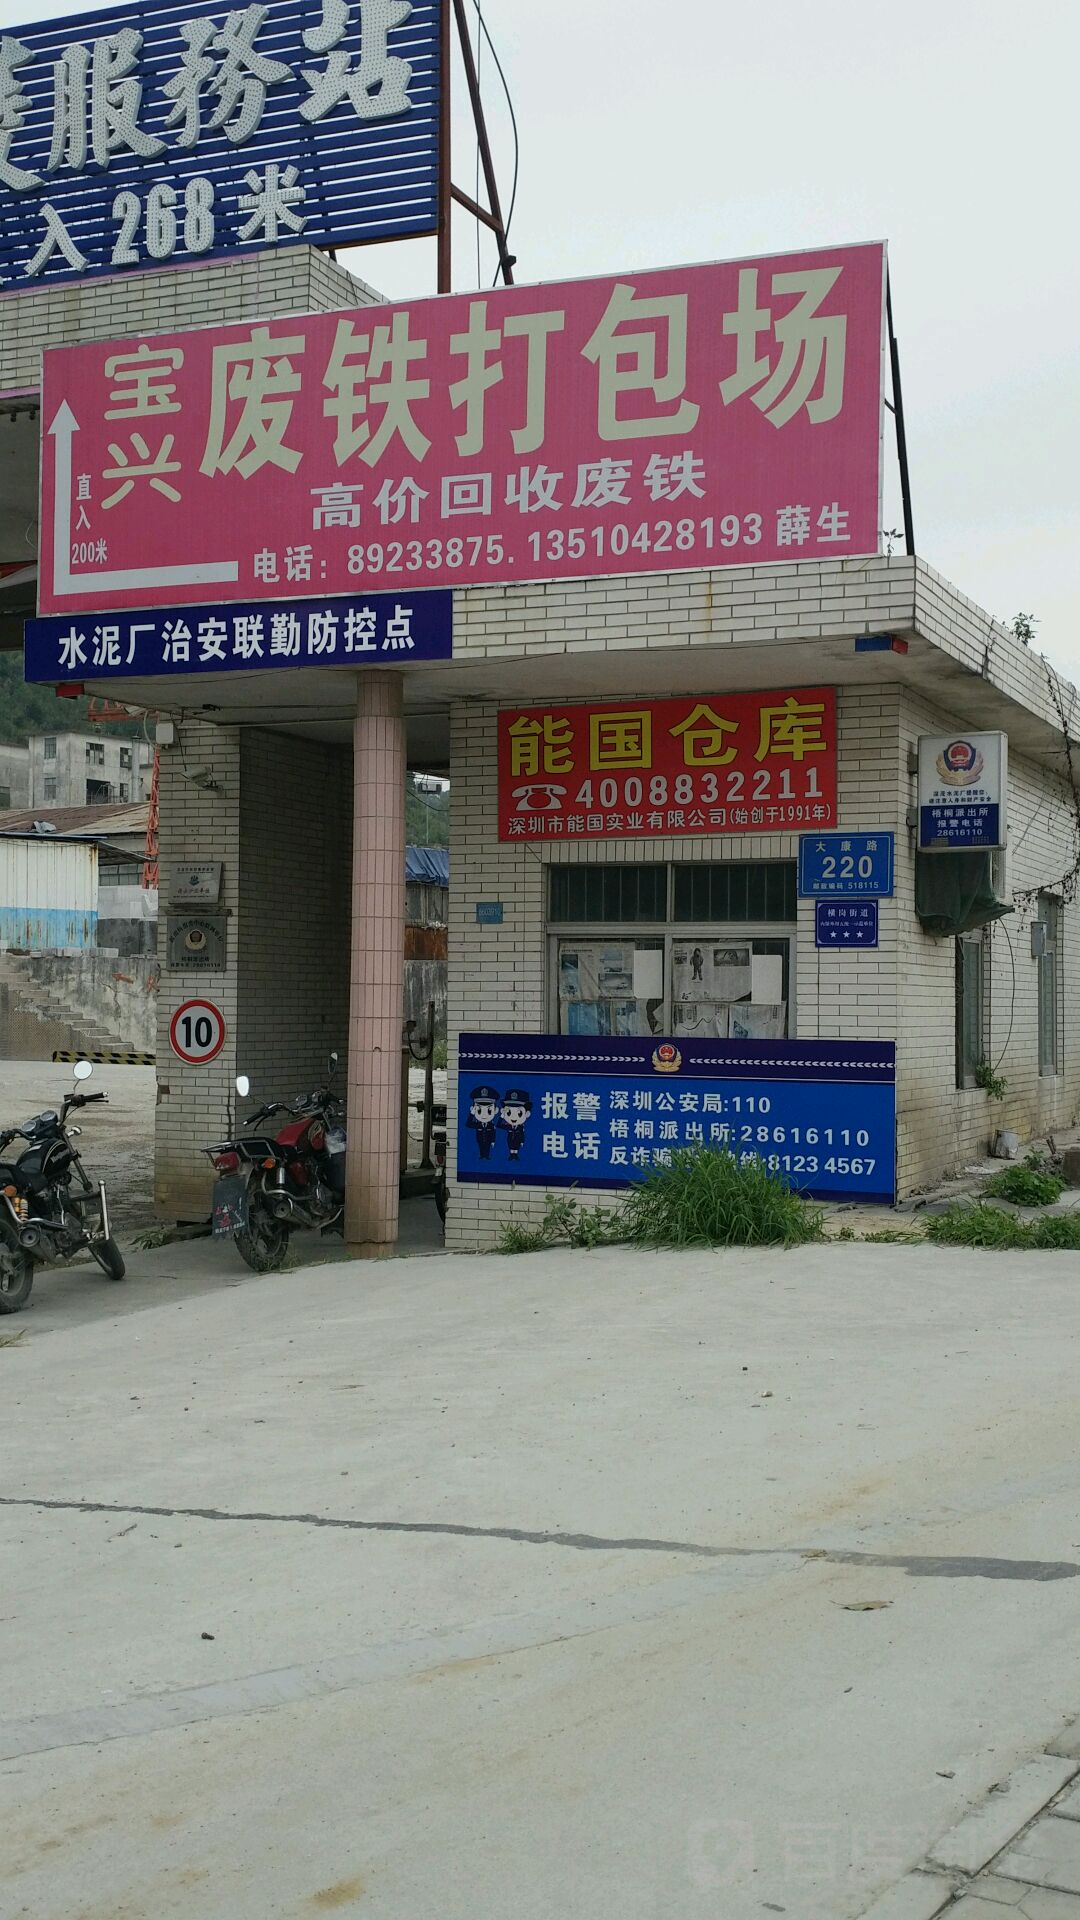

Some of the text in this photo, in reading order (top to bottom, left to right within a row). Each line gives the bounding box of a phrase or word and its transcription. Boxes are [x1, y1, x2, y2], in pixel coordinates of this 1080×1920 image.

[198, 266, 848, 480] 废铁打包场
[101, 344, 184, 510] 宝兴
[310, 450, 707, 530] 高价回收废铁
[71, 538, 108, 564] 200米
[58, 604, 416, 670] 水泥厂治安联勤防控点
[507, 696, 828, 778] 能国仓库
[575, 766, 824, 810] 4008832211
[936, 818, 984, 828] 报警电话
[937, 828, 983, 837] 28616110
[815, 840, 878, 853] 大康路
[822, 855, 873, 879] 220
[847, 880, 879, 890] 518115
[181, 1016, 213, 1048] 10
[541, 1091, 602, 1122] 报警
[542, 1130, 601, 1161] 电话
